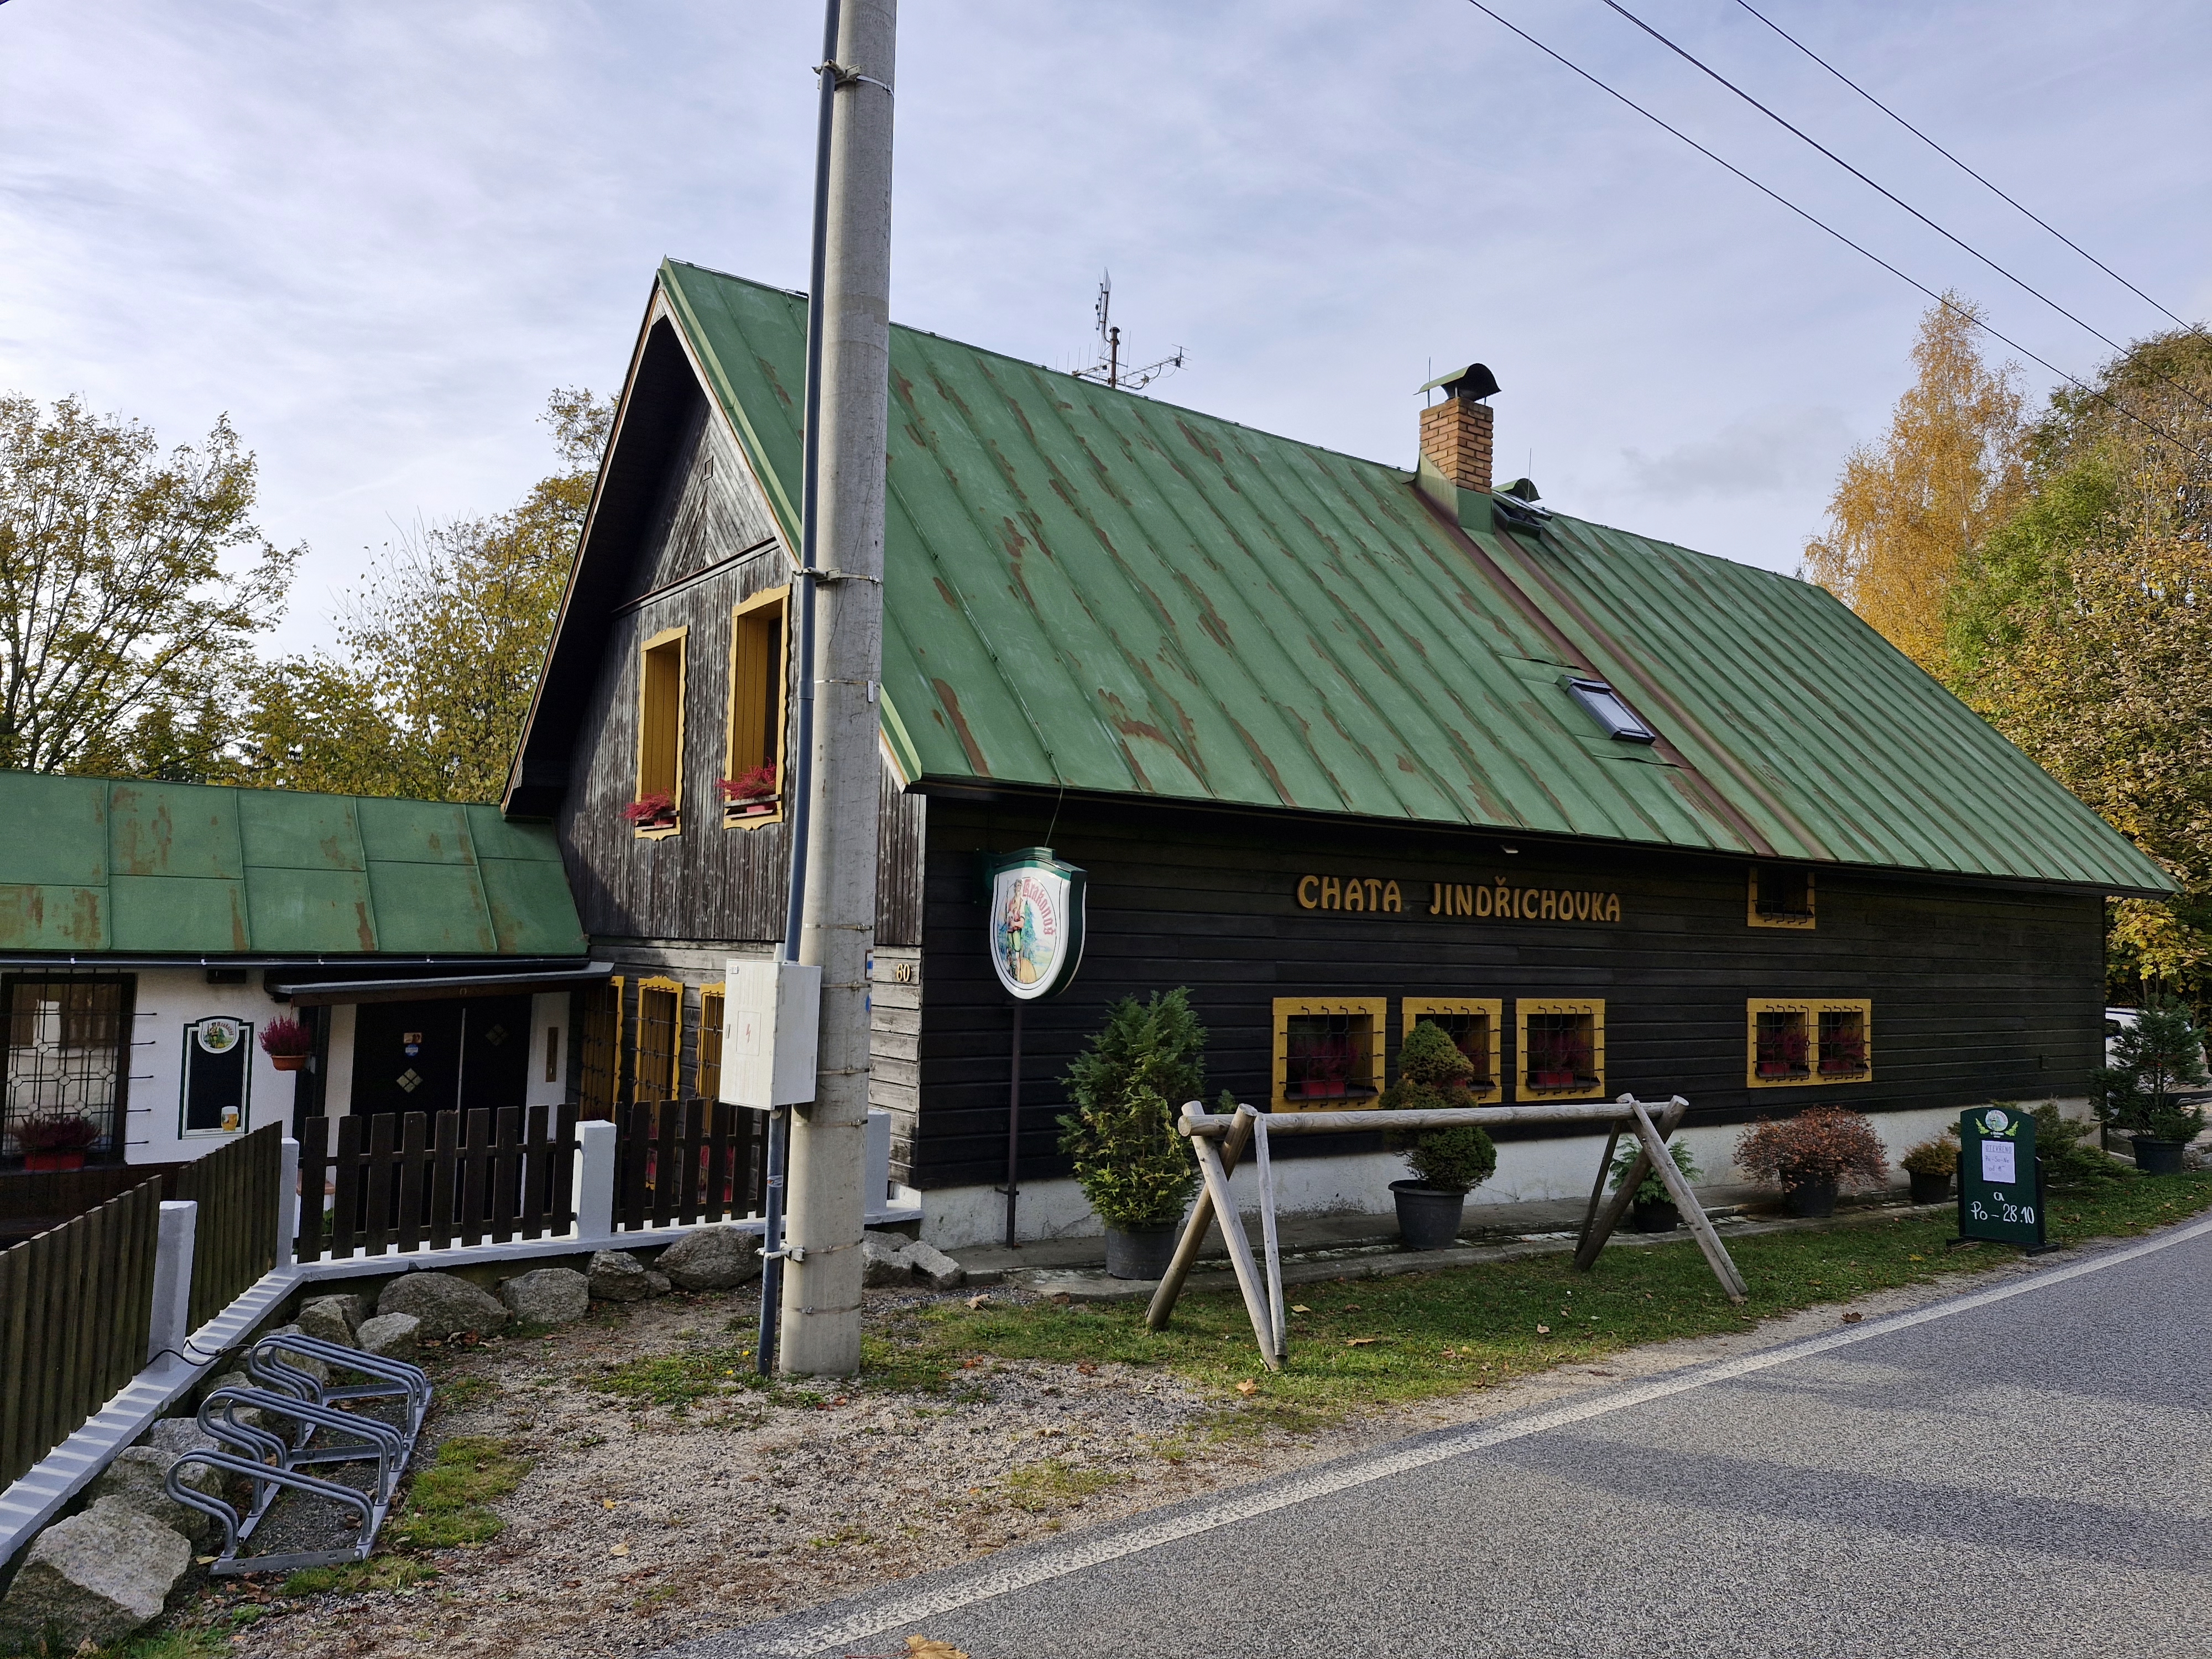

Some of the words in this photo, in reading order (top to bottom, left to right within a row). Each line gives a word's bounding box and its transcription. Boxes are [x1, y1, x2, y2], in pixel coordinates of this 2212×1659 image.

[1297, 875, 1401, 912] CHATA
[1430, 875, 1620, 922] JINDŘICHOVKA
[896, 963, 910, 982] 60
[1985, 1144, 2012, 1154] OTEVŘENO
[1993, 1192, 2005, 1201] a
[1970, 1201, 1988, 1220] Po
